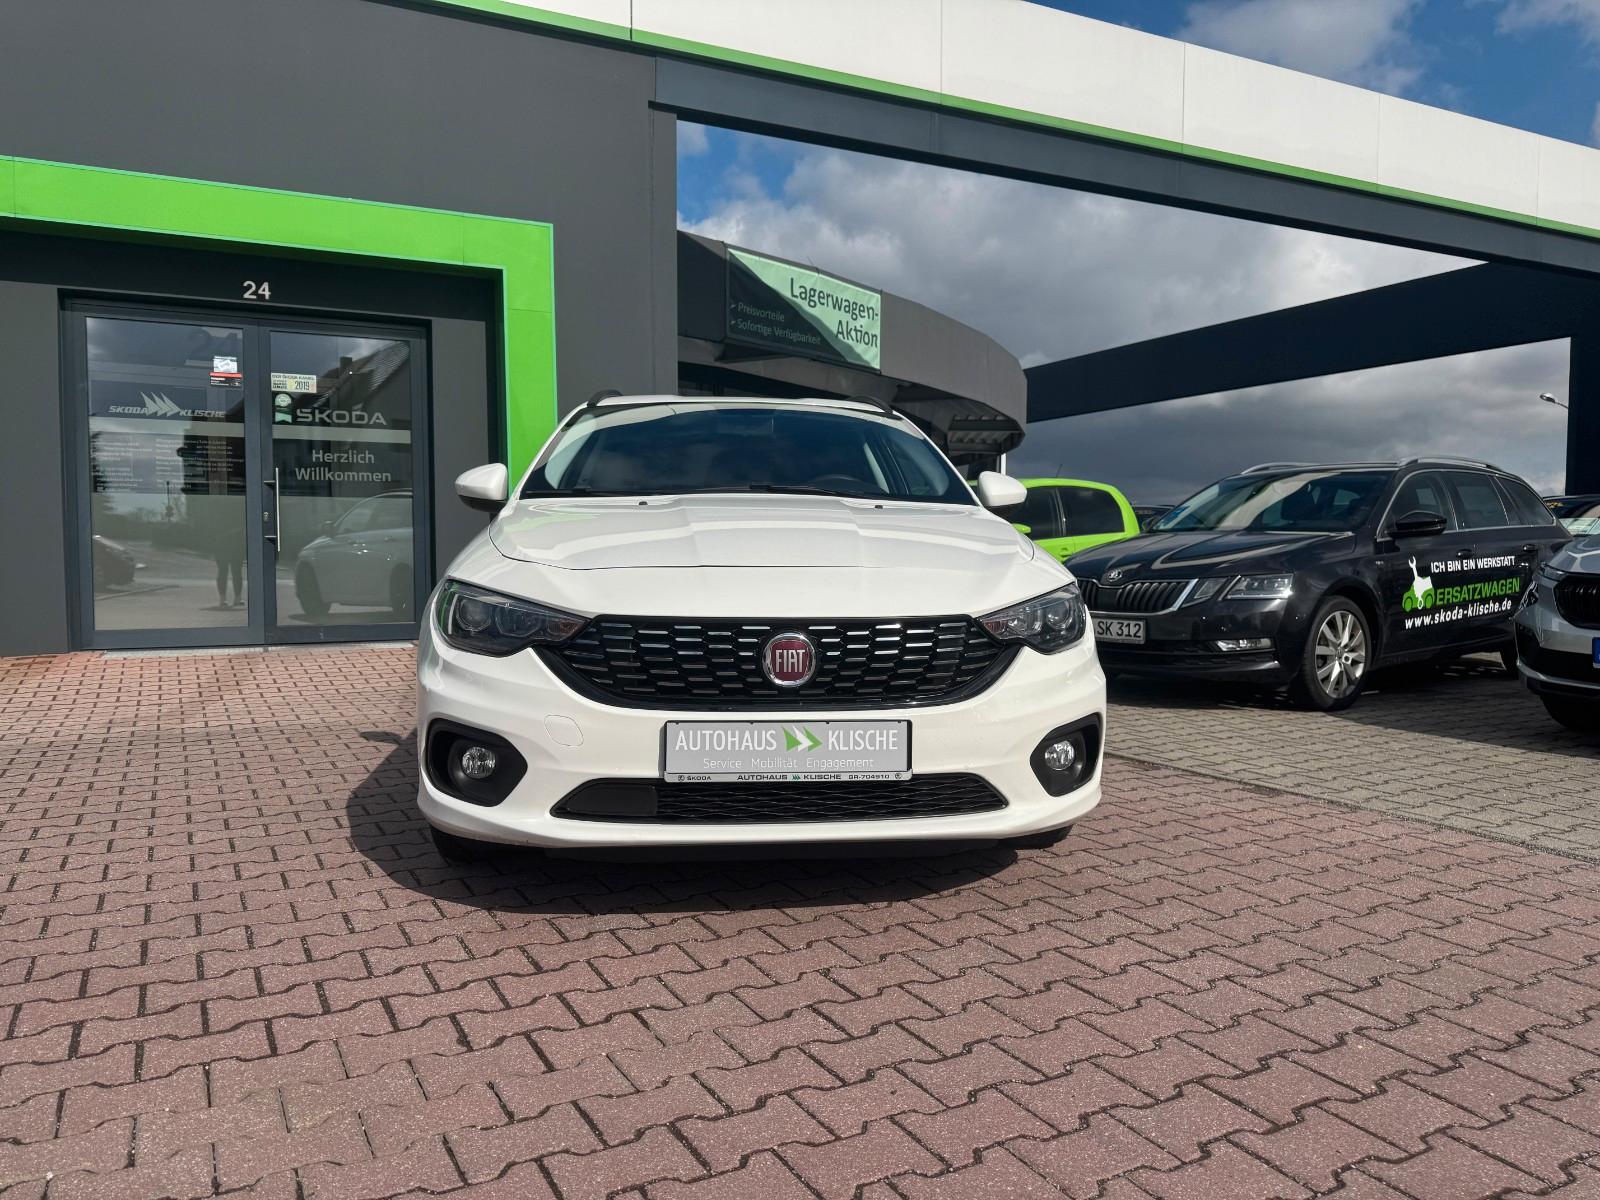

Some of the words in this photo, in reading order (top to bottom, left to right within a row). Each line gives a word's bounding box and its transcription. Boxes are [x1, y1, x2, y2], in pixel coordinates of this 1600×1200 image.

[243, 280, 271, 300] 24
[790, 277, 879, 321] Lagerwagen-
[738, 302, 785, 322] Preisvorteile
[737, 320, 773, 337] Sofortige
[835, 320, 878, 349] Aktion
[294, 380, 310, 391] 2019
[180, 409, 226, 418] KLISCHE
[312, 449, 375, 464] Herzlich
[295, 467, 392, 482] Willkommen
[1431, 561, 1446, 573] ICH
[1447, 559, 1462, 572] BIN
[1463, 558, 1476, 570] EIN
[1476, 556, 1516, 569] WERKSTATT
[1436, 577, 1521, 605] ERSATZWAGEN
[1405, 598, 1512, 630] www.skoda-klische.de
[1097, 620, 1114, 637] SK
[1116, 621, 1142, 638] 312
[775, 649, 806, 673] FIAT
[675, 729, 777, 751] AUTOHAUS
[827, 729, 898, 751] KLISCHE
[703, 757, 742, 770] Service
[751, 757, 799, 769] Mobilität
[806, 757, 874, 771] Engagement
[736, 773, 788, 781] AUTOHAUS
